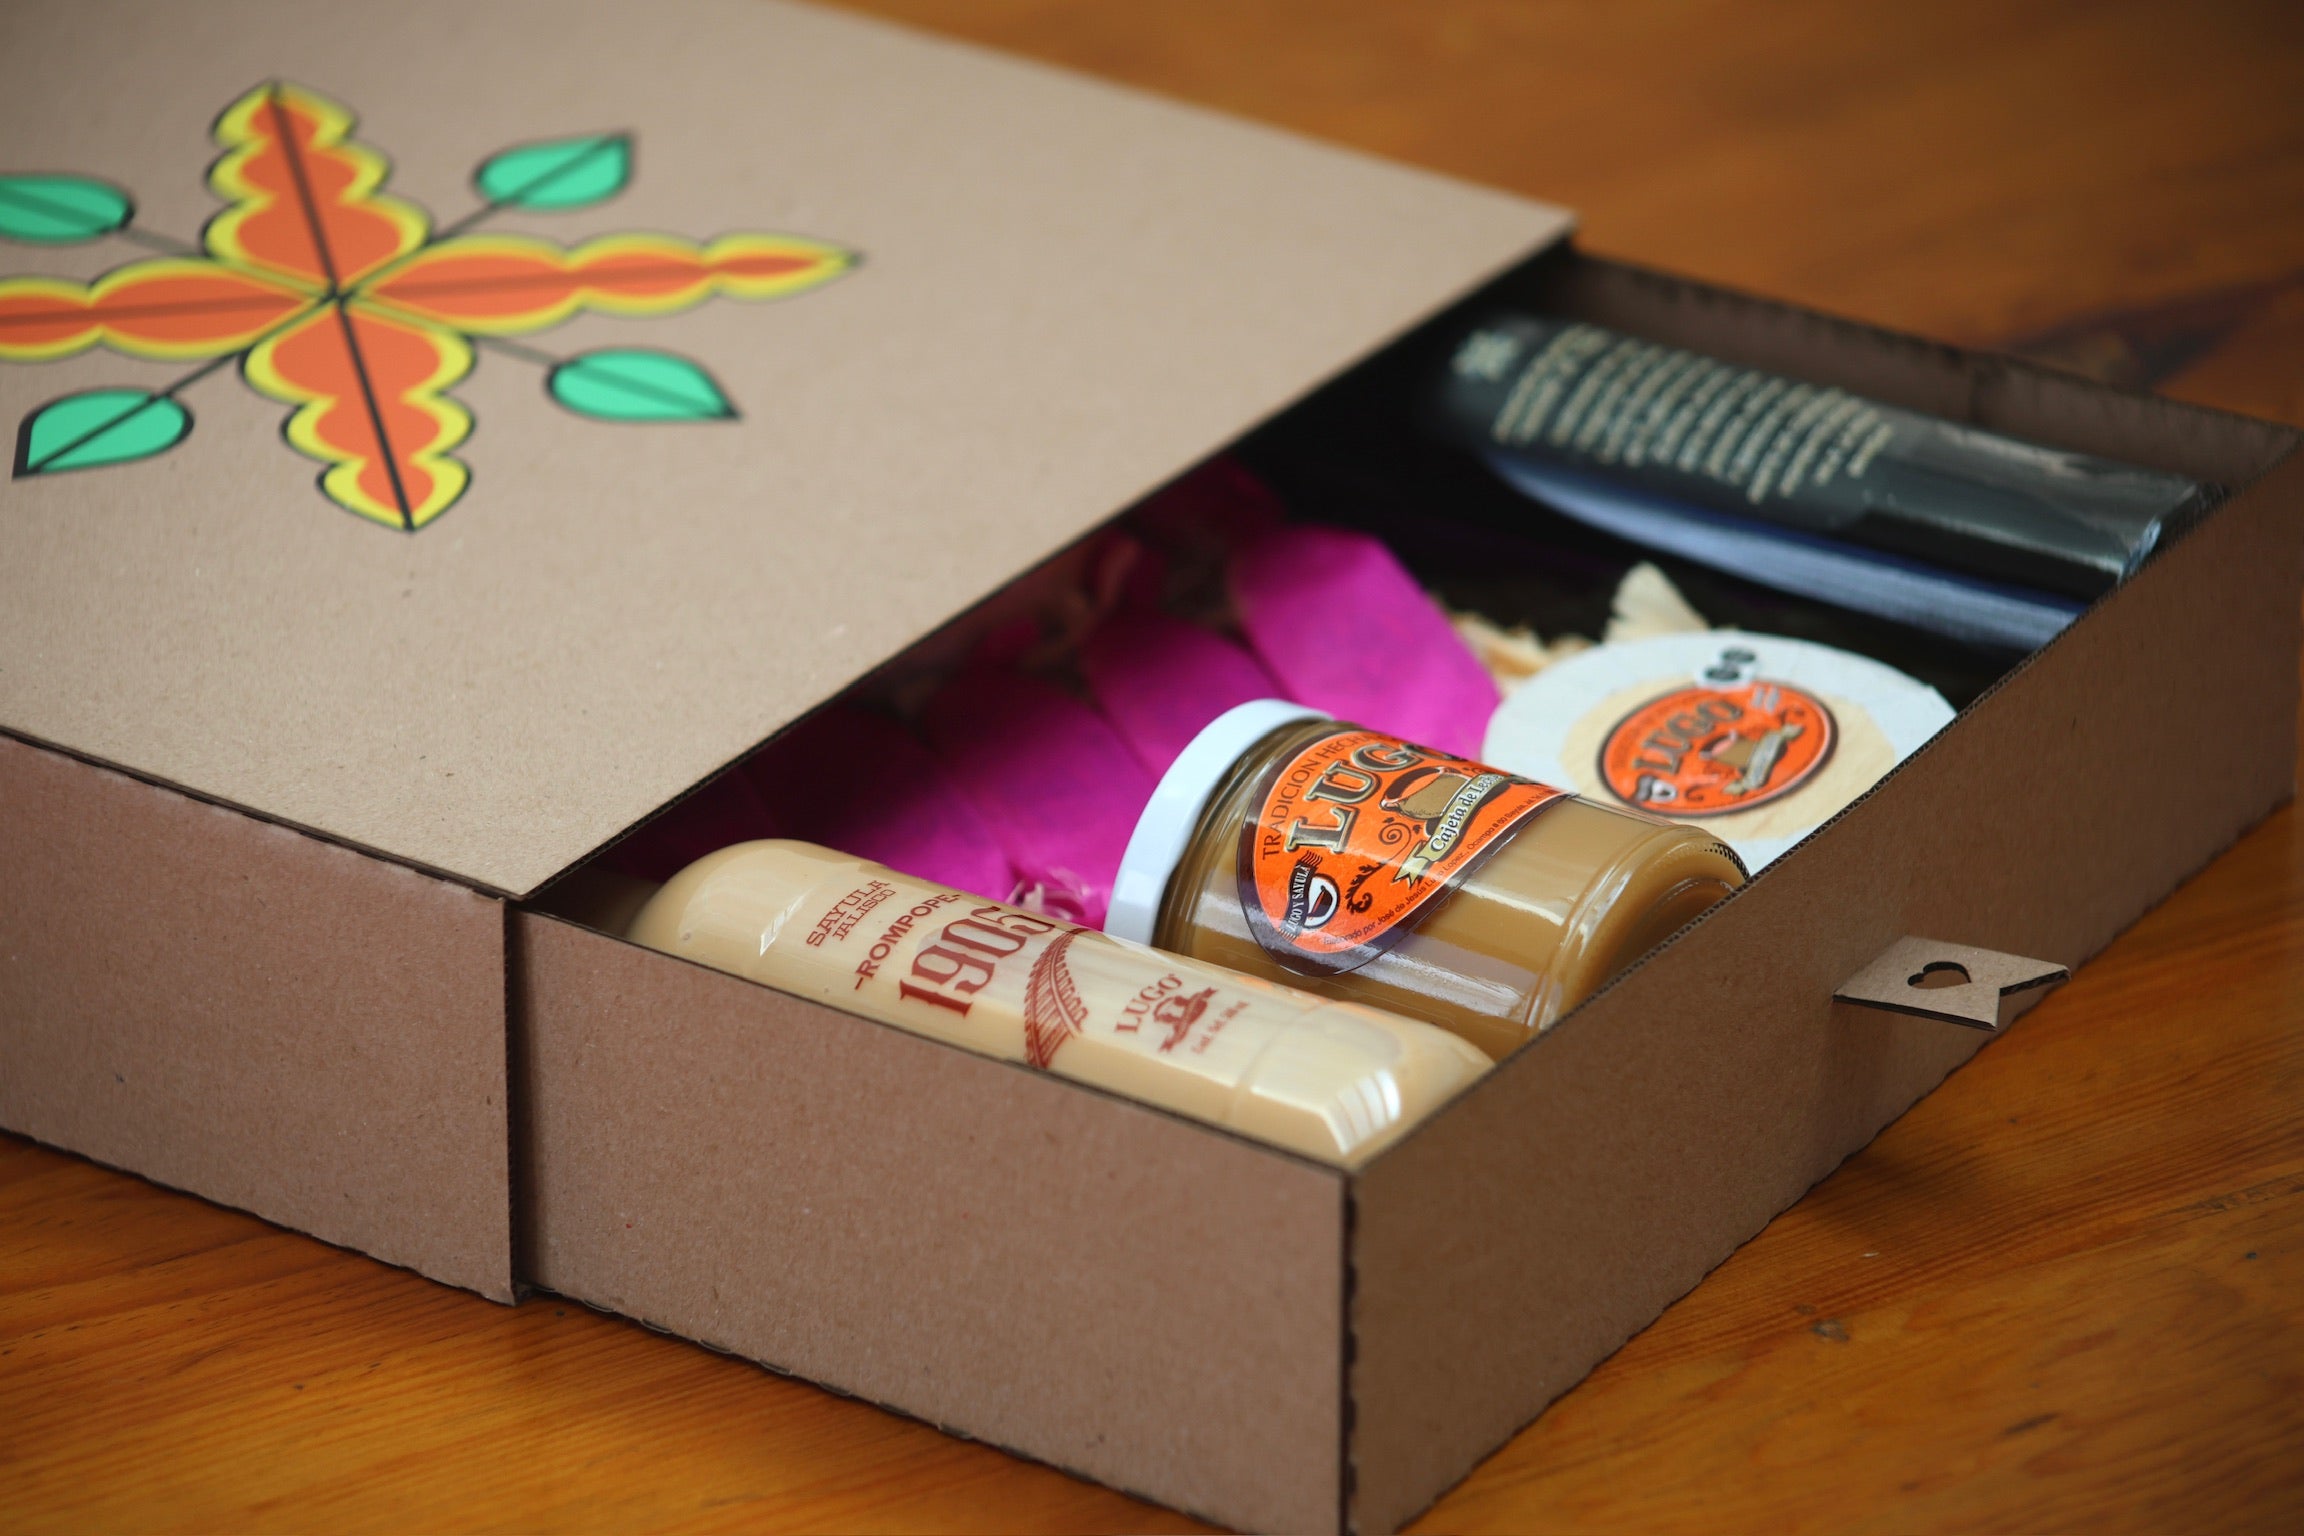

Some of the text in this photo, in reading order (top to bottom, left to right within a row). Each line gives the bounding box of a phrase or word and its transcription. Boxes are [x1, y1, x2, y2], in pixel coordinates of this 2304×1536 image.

[1631, 699, 1744, 774] LUGO
[1262, 758, 1322, 860] TRADICION
[1430, 804, 1467, 852] Cajeta
[1461, 791, 1478, 807] de
[806, 880, 891, 947] SAYULA
[1363, 921, 1377, 935] por
[1377, 910, 1395, 926] José
[1394, 902, 1406, 914] de
[1405, 886, 1427, 906] Jesús
[1467, 826, 1496, 850] Ocampo
[831, 888, 897, 941] JALISCO
[1286, 908, 1304, 932] LUGO
[899, 905, 1056, 1019] 1905
[1114, 973, 1183, 1034] LUGO
